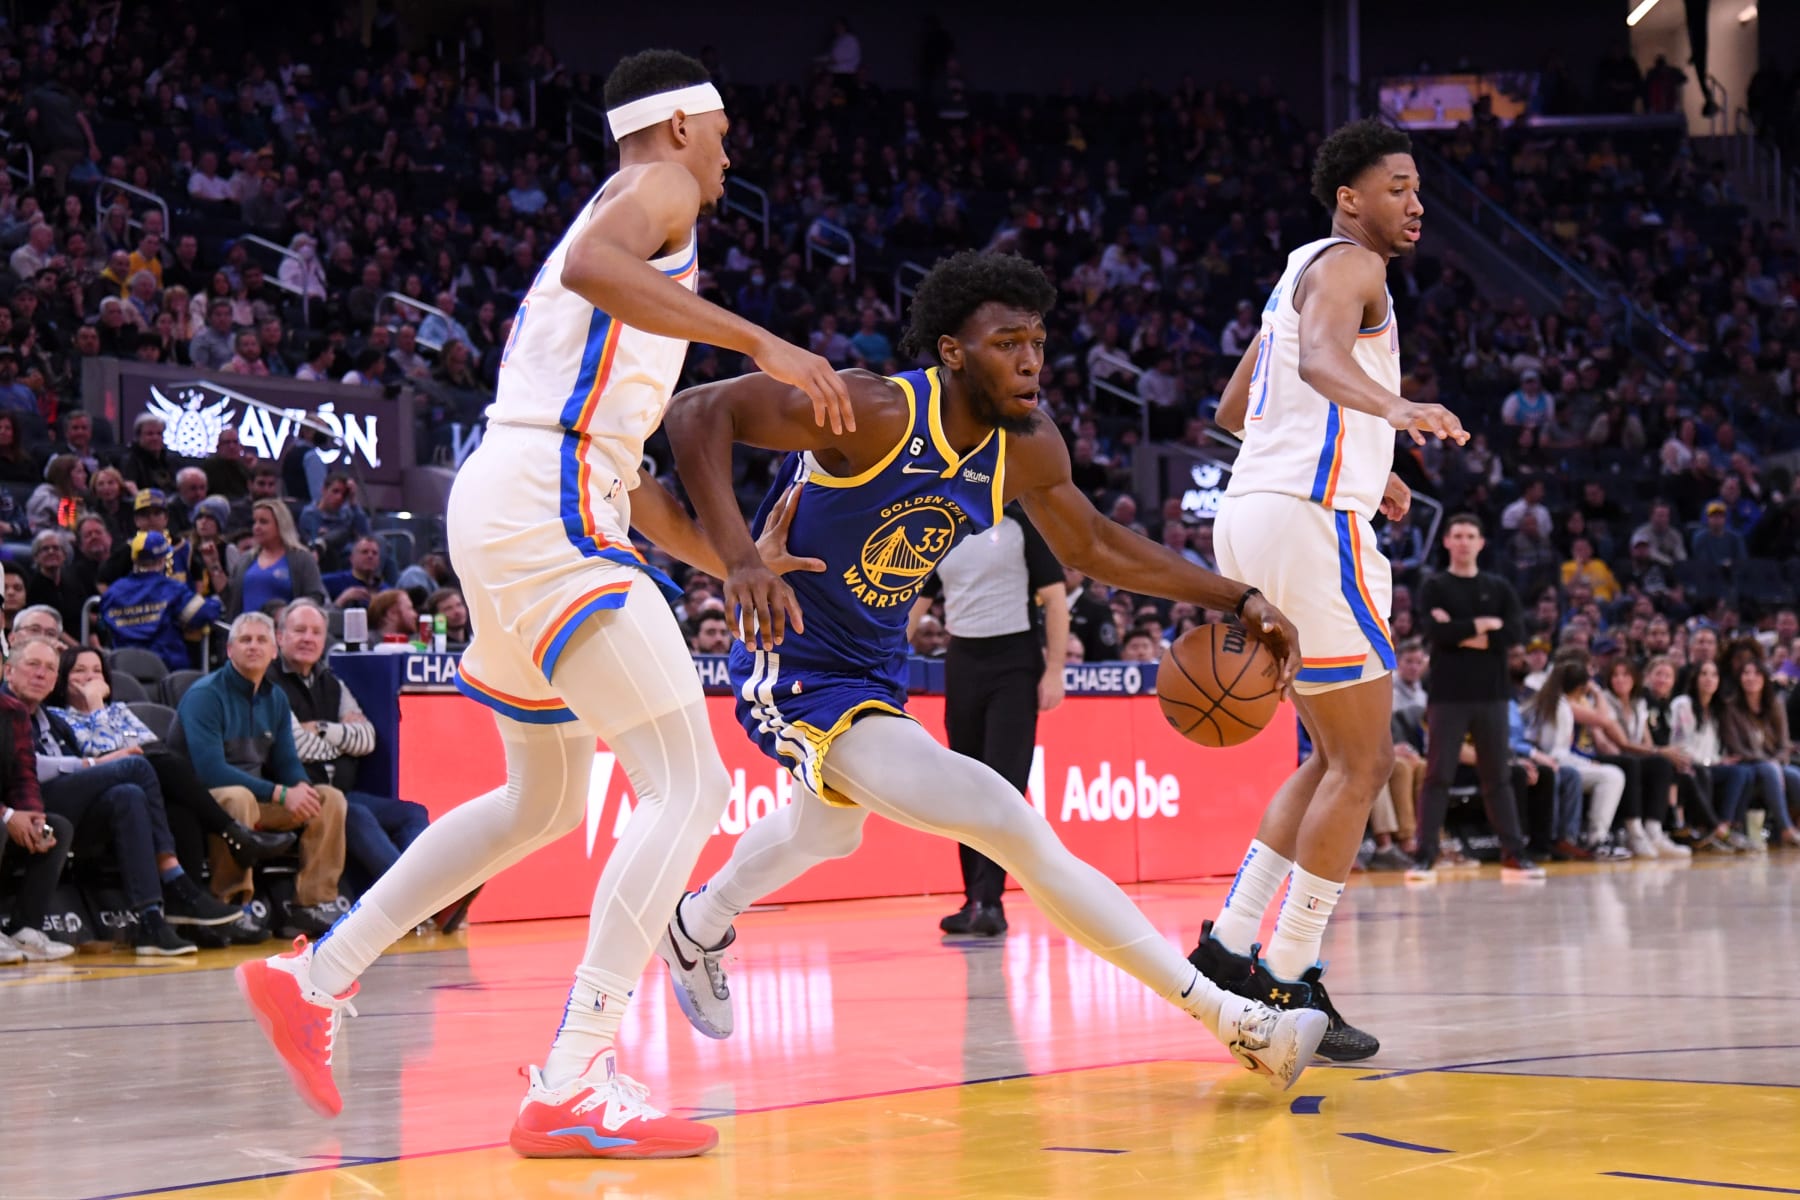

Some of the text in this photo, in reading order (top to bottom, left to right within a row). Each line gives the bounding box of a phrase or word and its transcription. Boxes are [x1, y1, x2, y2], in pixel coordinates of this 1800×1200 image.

[909, 436, 925, 456] 6
[880, 495, 944, 518] GOLDEN
[915, 527, 952, 552] 33
[406, 655, 458, 683] CHA
[1063, 667, 1123, 692] CHASE
[1059, 759, 1181, 823] Adobe
